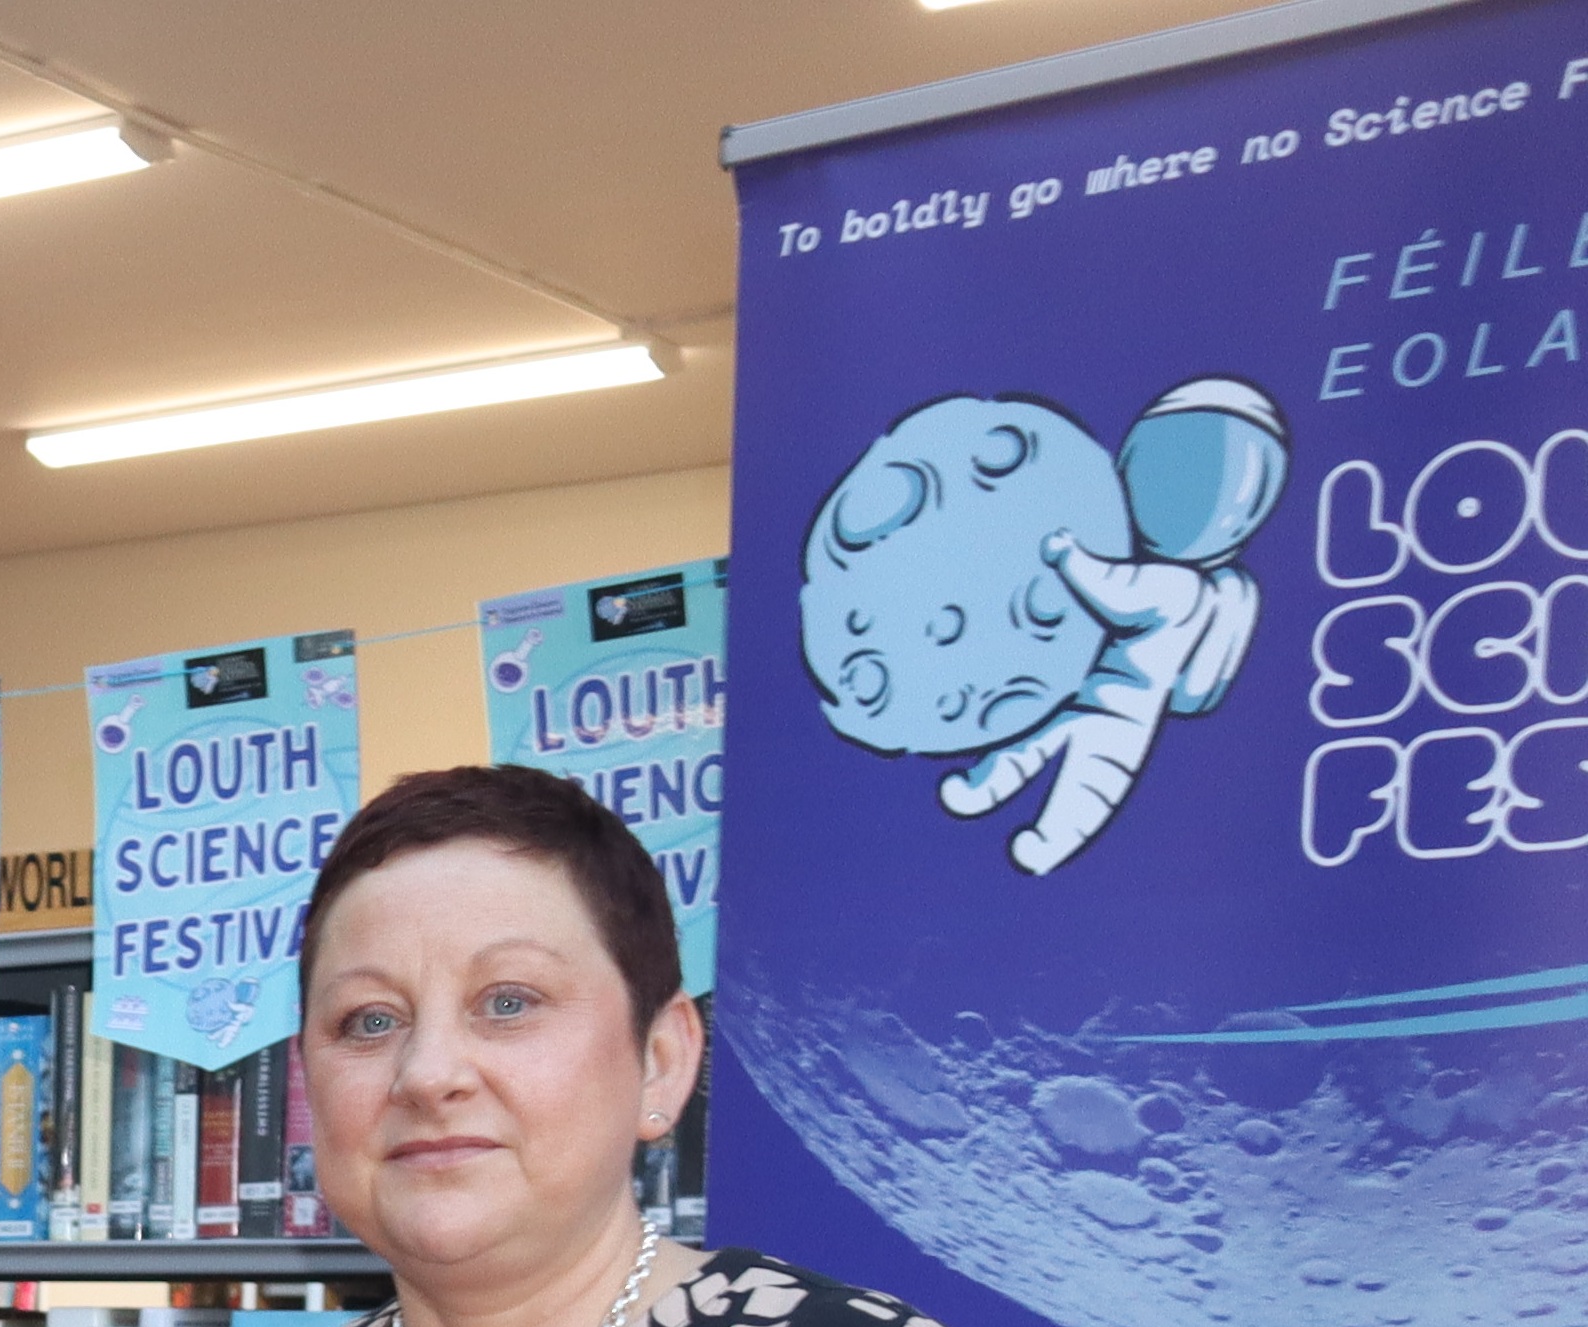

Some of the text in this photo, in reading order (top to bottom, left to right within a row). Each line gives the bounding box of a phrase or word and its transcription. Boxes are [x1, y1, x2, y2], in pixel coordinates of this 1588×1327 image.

[778, 76, 1531, 258] To boldly go where no Science
[1318, 309, 1581, 401] EOLA
[134, 725, 316, 810] LOUTH
